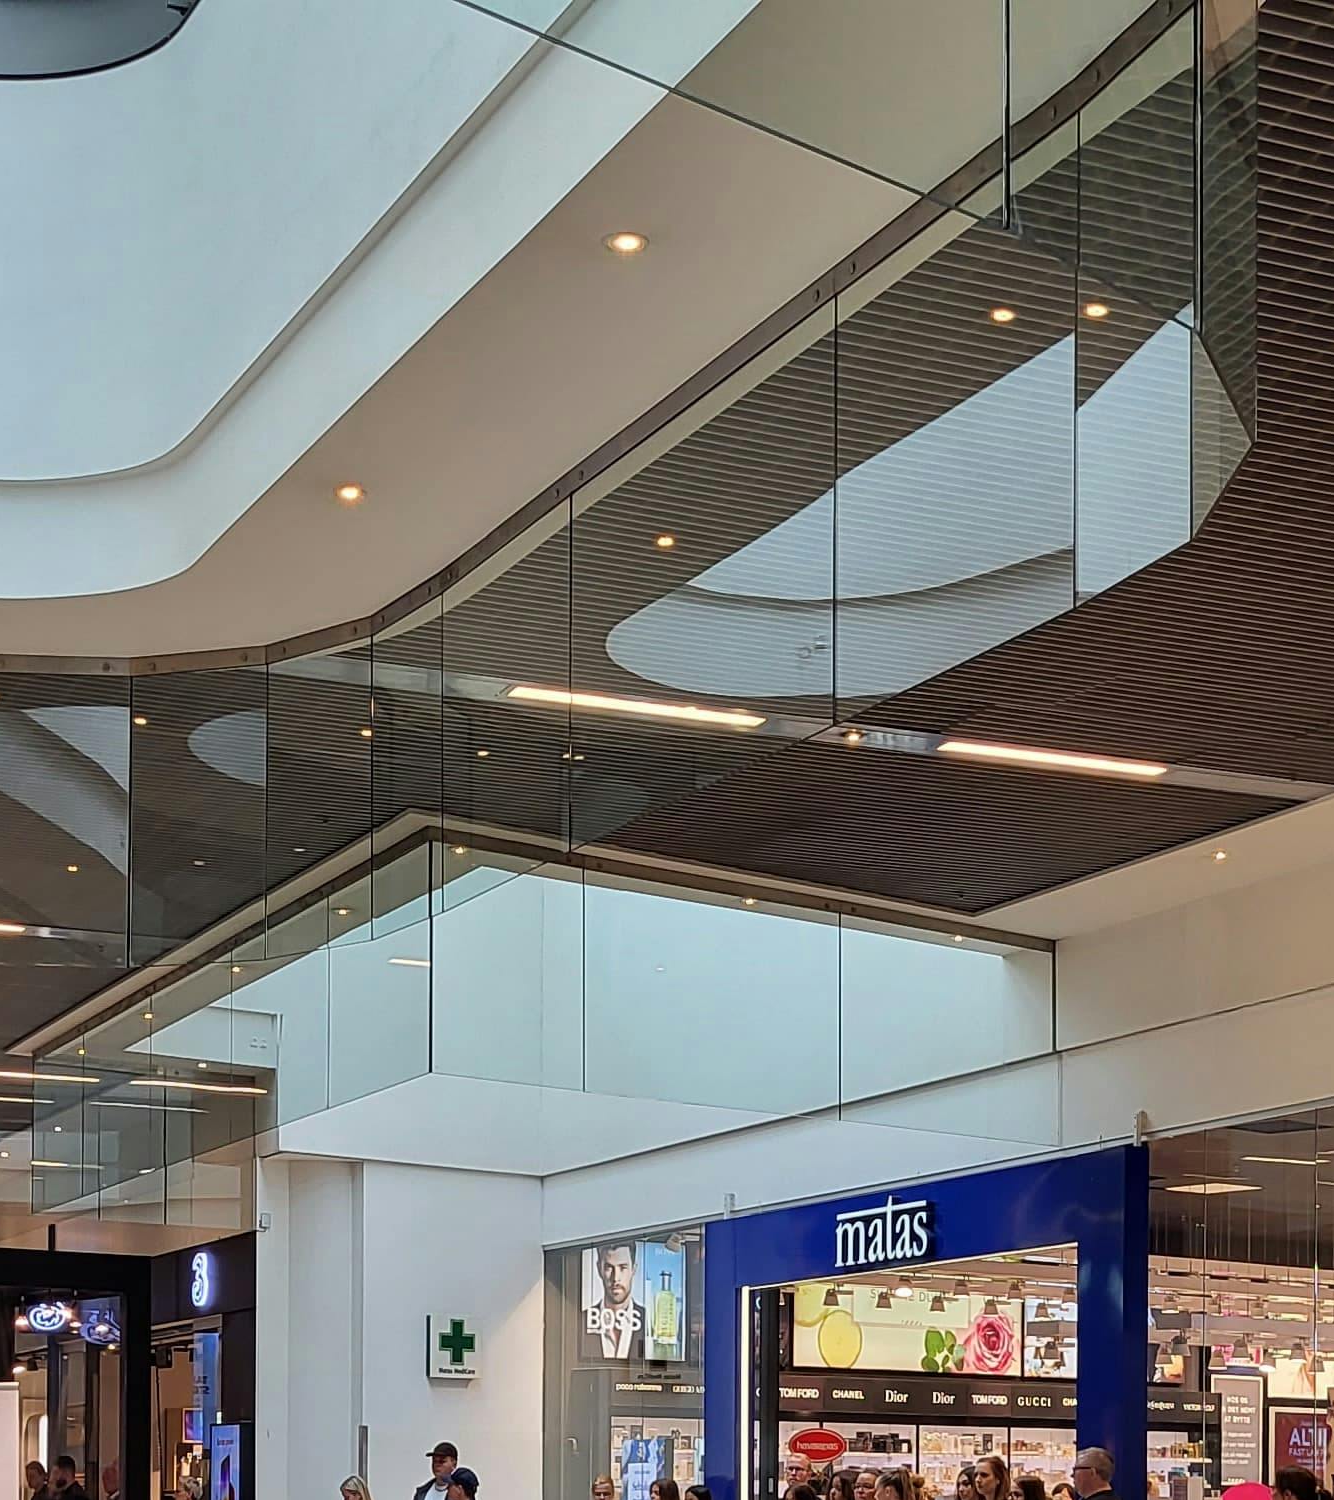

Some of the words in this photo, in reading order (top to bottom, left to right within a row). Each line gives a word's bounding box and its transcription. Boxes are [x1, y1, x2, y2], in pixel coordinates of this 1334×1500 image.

[834, 1195, 928, 1267] matas
[192, 1253, 208, 1306] 3
[587, 1308, 642, 1331] BOSS
[779, 1387, 798, 1398] TOM
[798, 1388, 819, 1398] FORD
[832, 1389, 865, 1399] CHANEL
[885, 1390, 909, 1403] Dior
[932, 1391, 956, 1404] Dior
[1018, 1397, 1052, 1408] GUCCI
[1062, 1398, 1077, 1406] CHA
